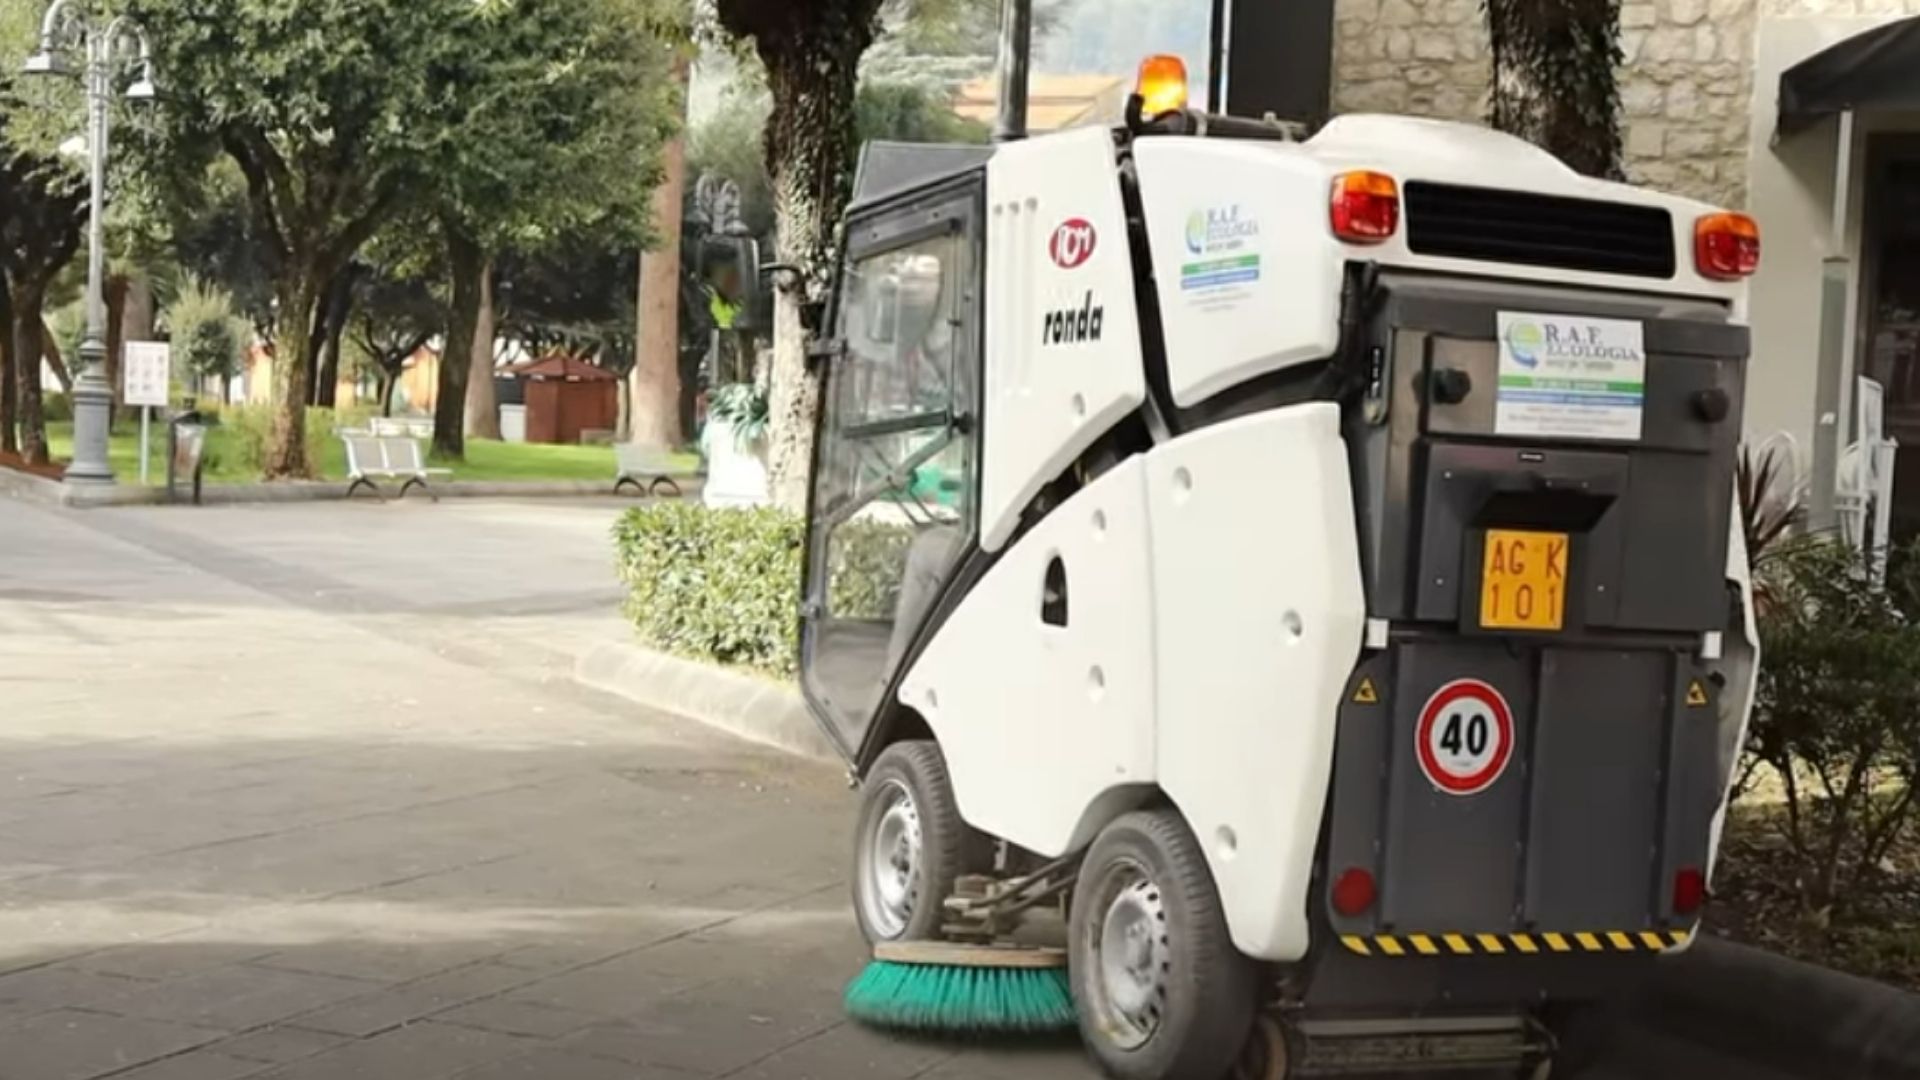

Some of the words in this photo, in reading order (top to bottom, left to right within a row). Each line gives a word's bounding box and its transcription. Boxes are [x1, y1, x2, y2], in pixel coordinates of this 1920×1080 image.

[1042, 289, 1104, 346] ronda
[1546, 343, 1640, 362] ECOLOGIA
[1489, 539, 1526, 576] AG
[1545, 539, 1565, 580] K
[1440, 711, 1488, 758] 40
